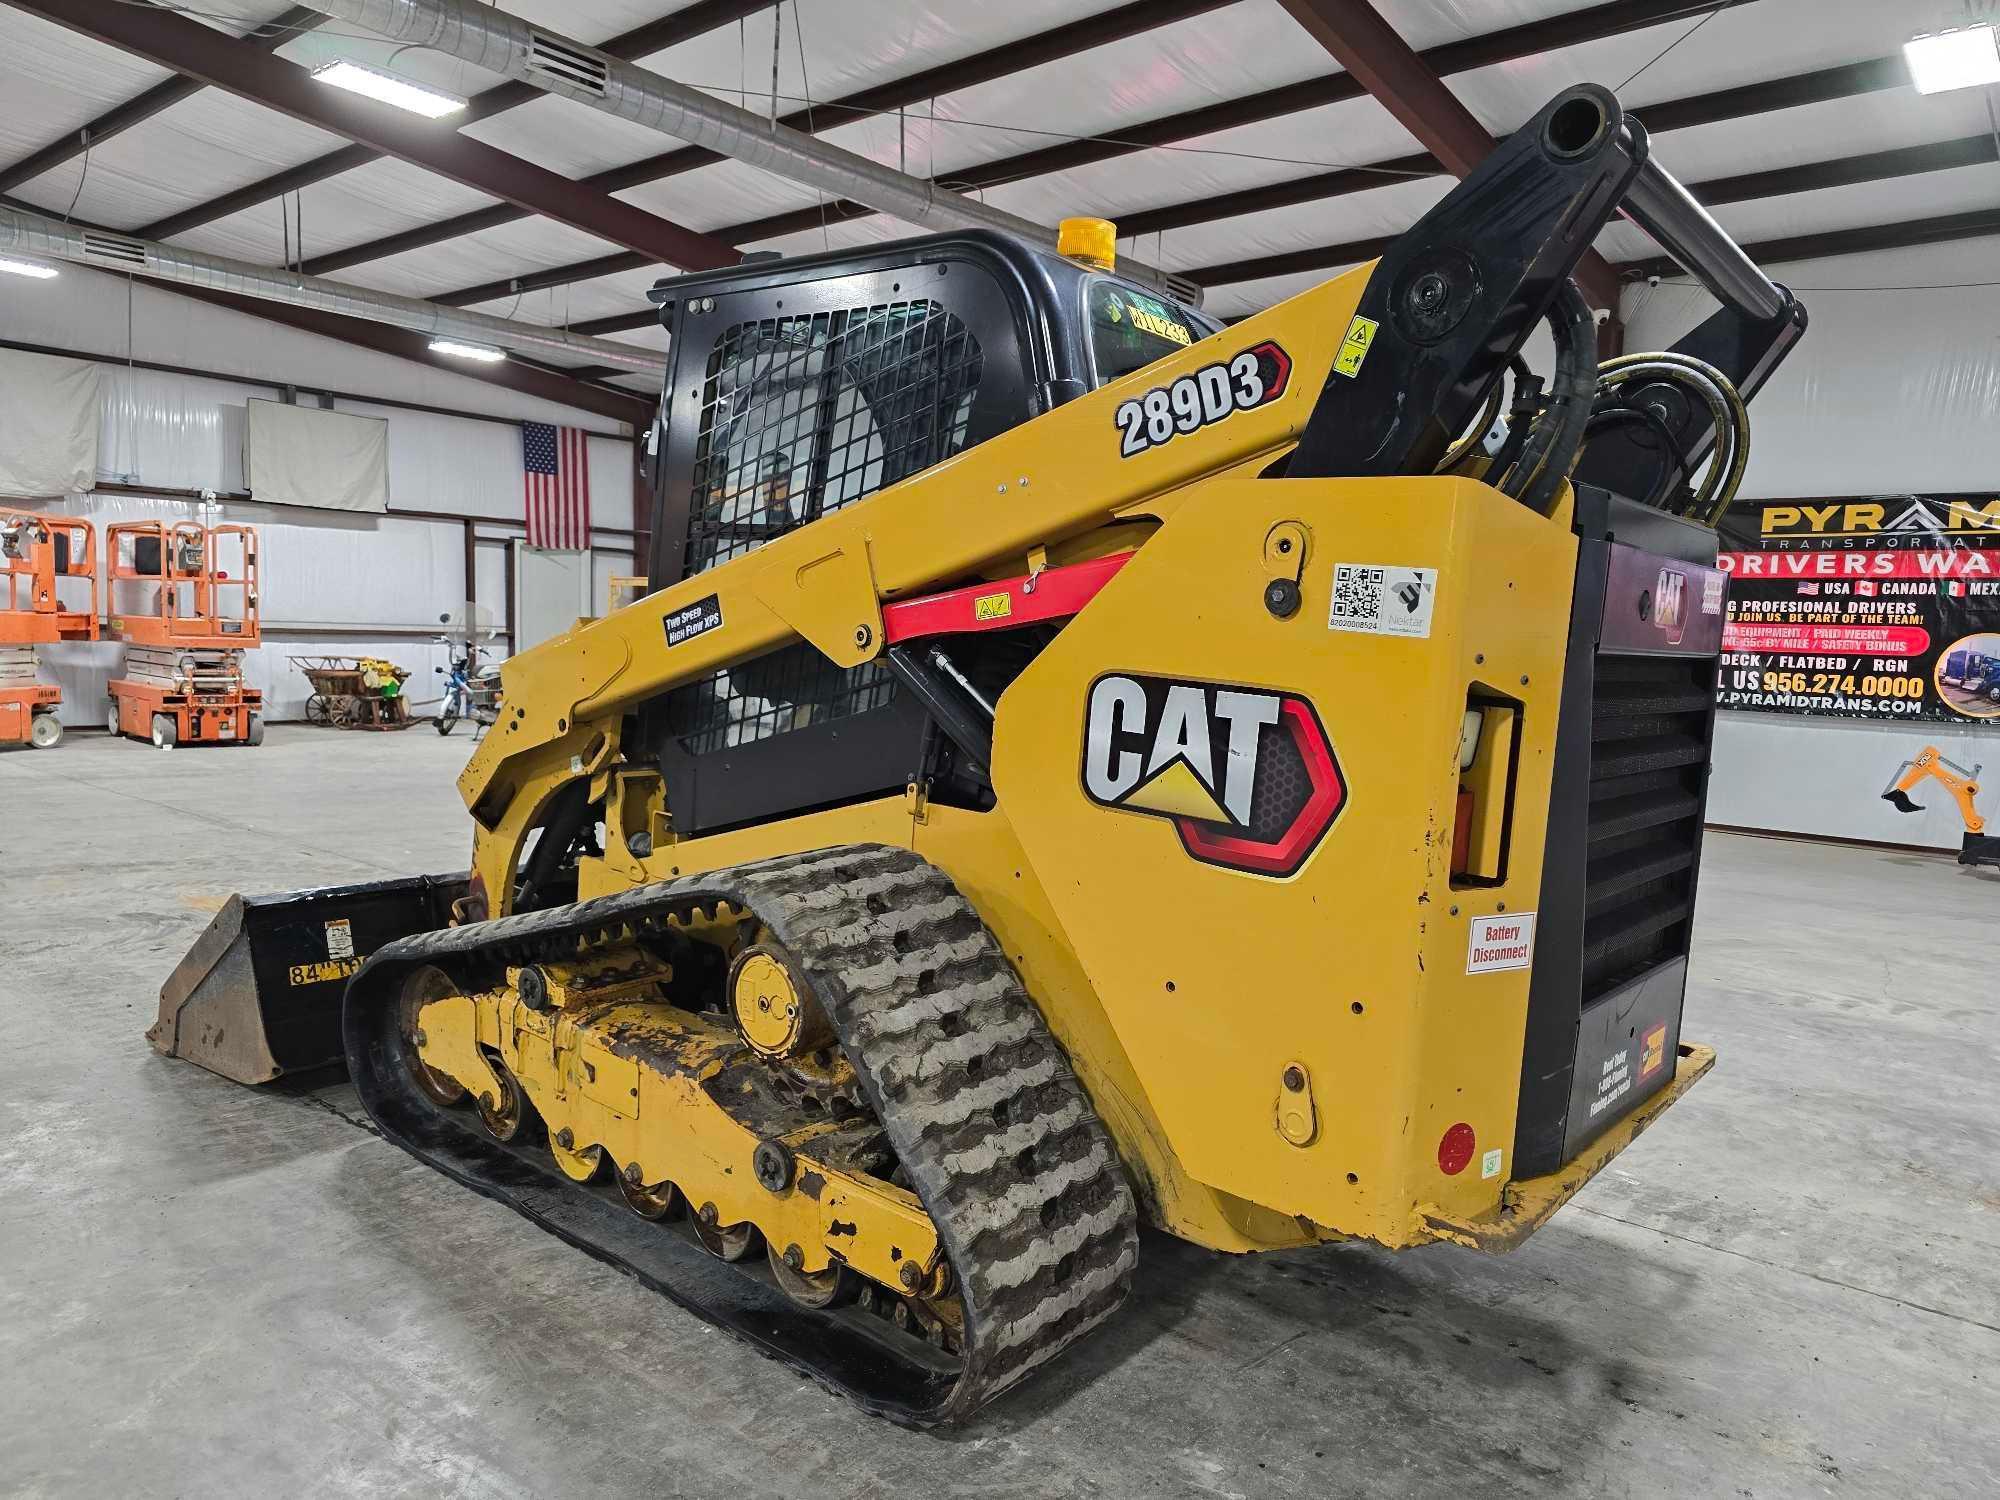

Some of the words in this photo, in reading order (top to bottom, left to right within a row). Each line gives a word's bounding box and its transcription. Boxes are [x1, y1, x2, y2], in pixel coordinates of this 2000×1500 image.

[1117, 353, 1263, 456] 289D3
[1716, 554, 1895, 575] DRIVERS
[1824, 582, 1850, 595] USA
[1881, 582, 1937, 596] CANADA
[1969, 582, 2000, 596] MEX
[1741, 600, 1842, 614] PROFESIONAL
[1847, 602, 1917, 615] DRIVERS
[704, 612, 719, 629] XPS
[1737, 612, 1763, 622] JOIN
[1789, 613, 1804, 623] BE
[1807, 613, 1838, 624] PART
[1841, 614, 1857, 624] OF
[1860, 614, 1883, 624] THE
[1887, 615, 1924, 625] TEAM!
[1845, 629, 1889, 640] WEEKLY
[1821, 640, 1861, 650] SAFETY
[1865, 641, 1907, 652] BONUS
[1780, 655, 1847, 670] FLATBED
[1873, 659, 1908, 673] RGN
[1733, 670, 1760, 691] US
[1763, 671, 1924, 698] 956.274.0000
[1086, 676, 1280, 828] CAT
[1485, 926, 1521, 942] Battery
[1473, 944, 1528, 963] Disconnect
